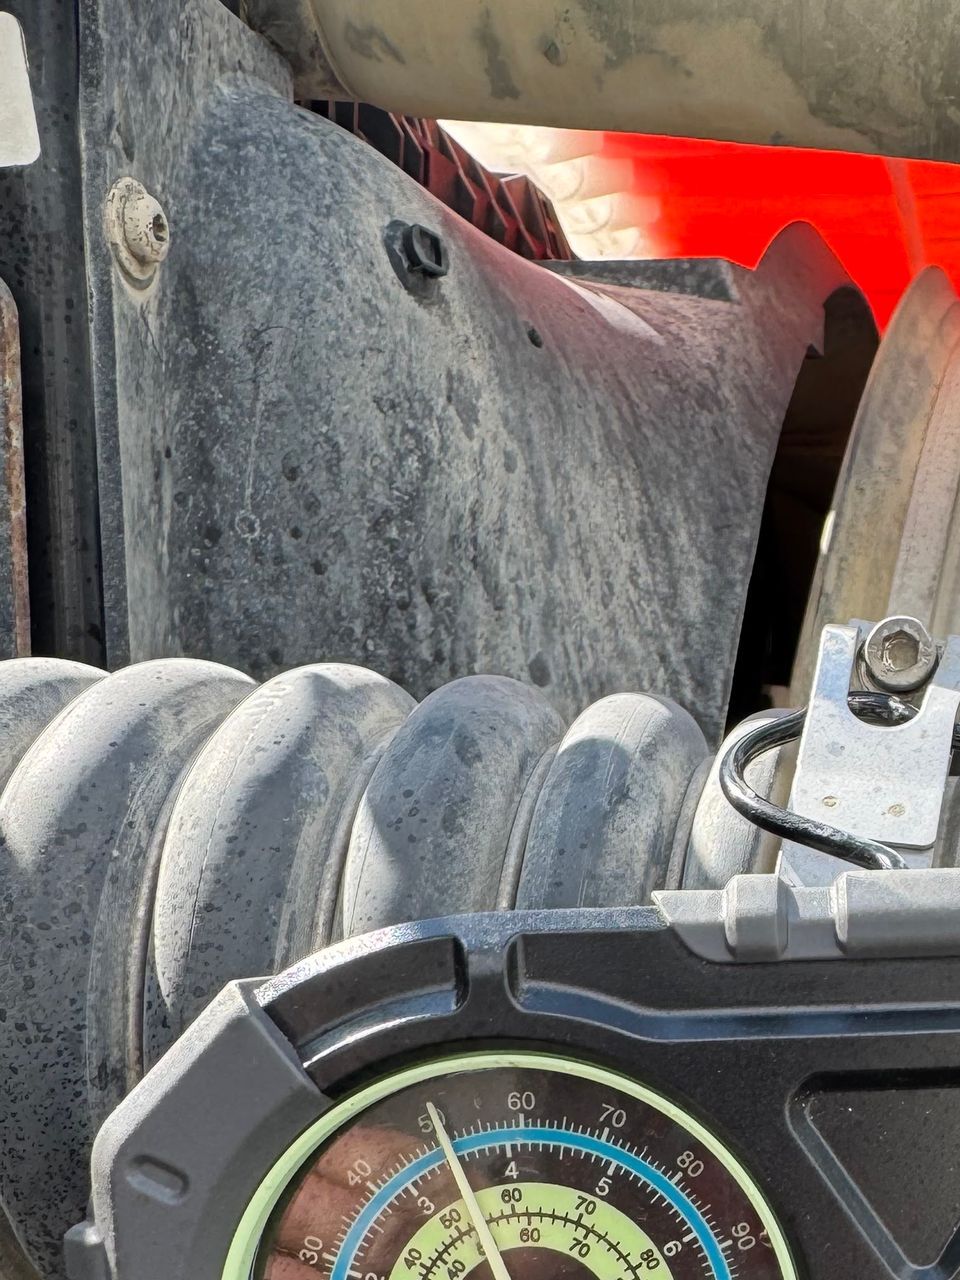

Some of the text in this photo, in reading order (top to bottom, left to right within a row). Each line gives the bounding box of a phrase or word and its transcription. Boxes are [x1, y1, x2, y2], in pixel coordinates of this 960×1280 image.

[507, 1092, 535, 1110] 60
[600, 1104, 627, 1128] 70
[347, 1159, 371, 1187] 40
[504, 1161, 519, 1179] 4
[677, 1150, 704, 1178] 80
[595, 1177, 612, 1196] 5
[417, 1196, 435, 1214] 3
[576, 1195, 597, 1216] 70
[732, 1222, 755, 1250] 90
[299, 1236, 323, 1265] 30
[404, 1248, 422, 1270] 40
[568, 1237, 591, 1259] 70
[447, 1259, 466, 1280] 40
[640, 1248, 660, 1271] 80
